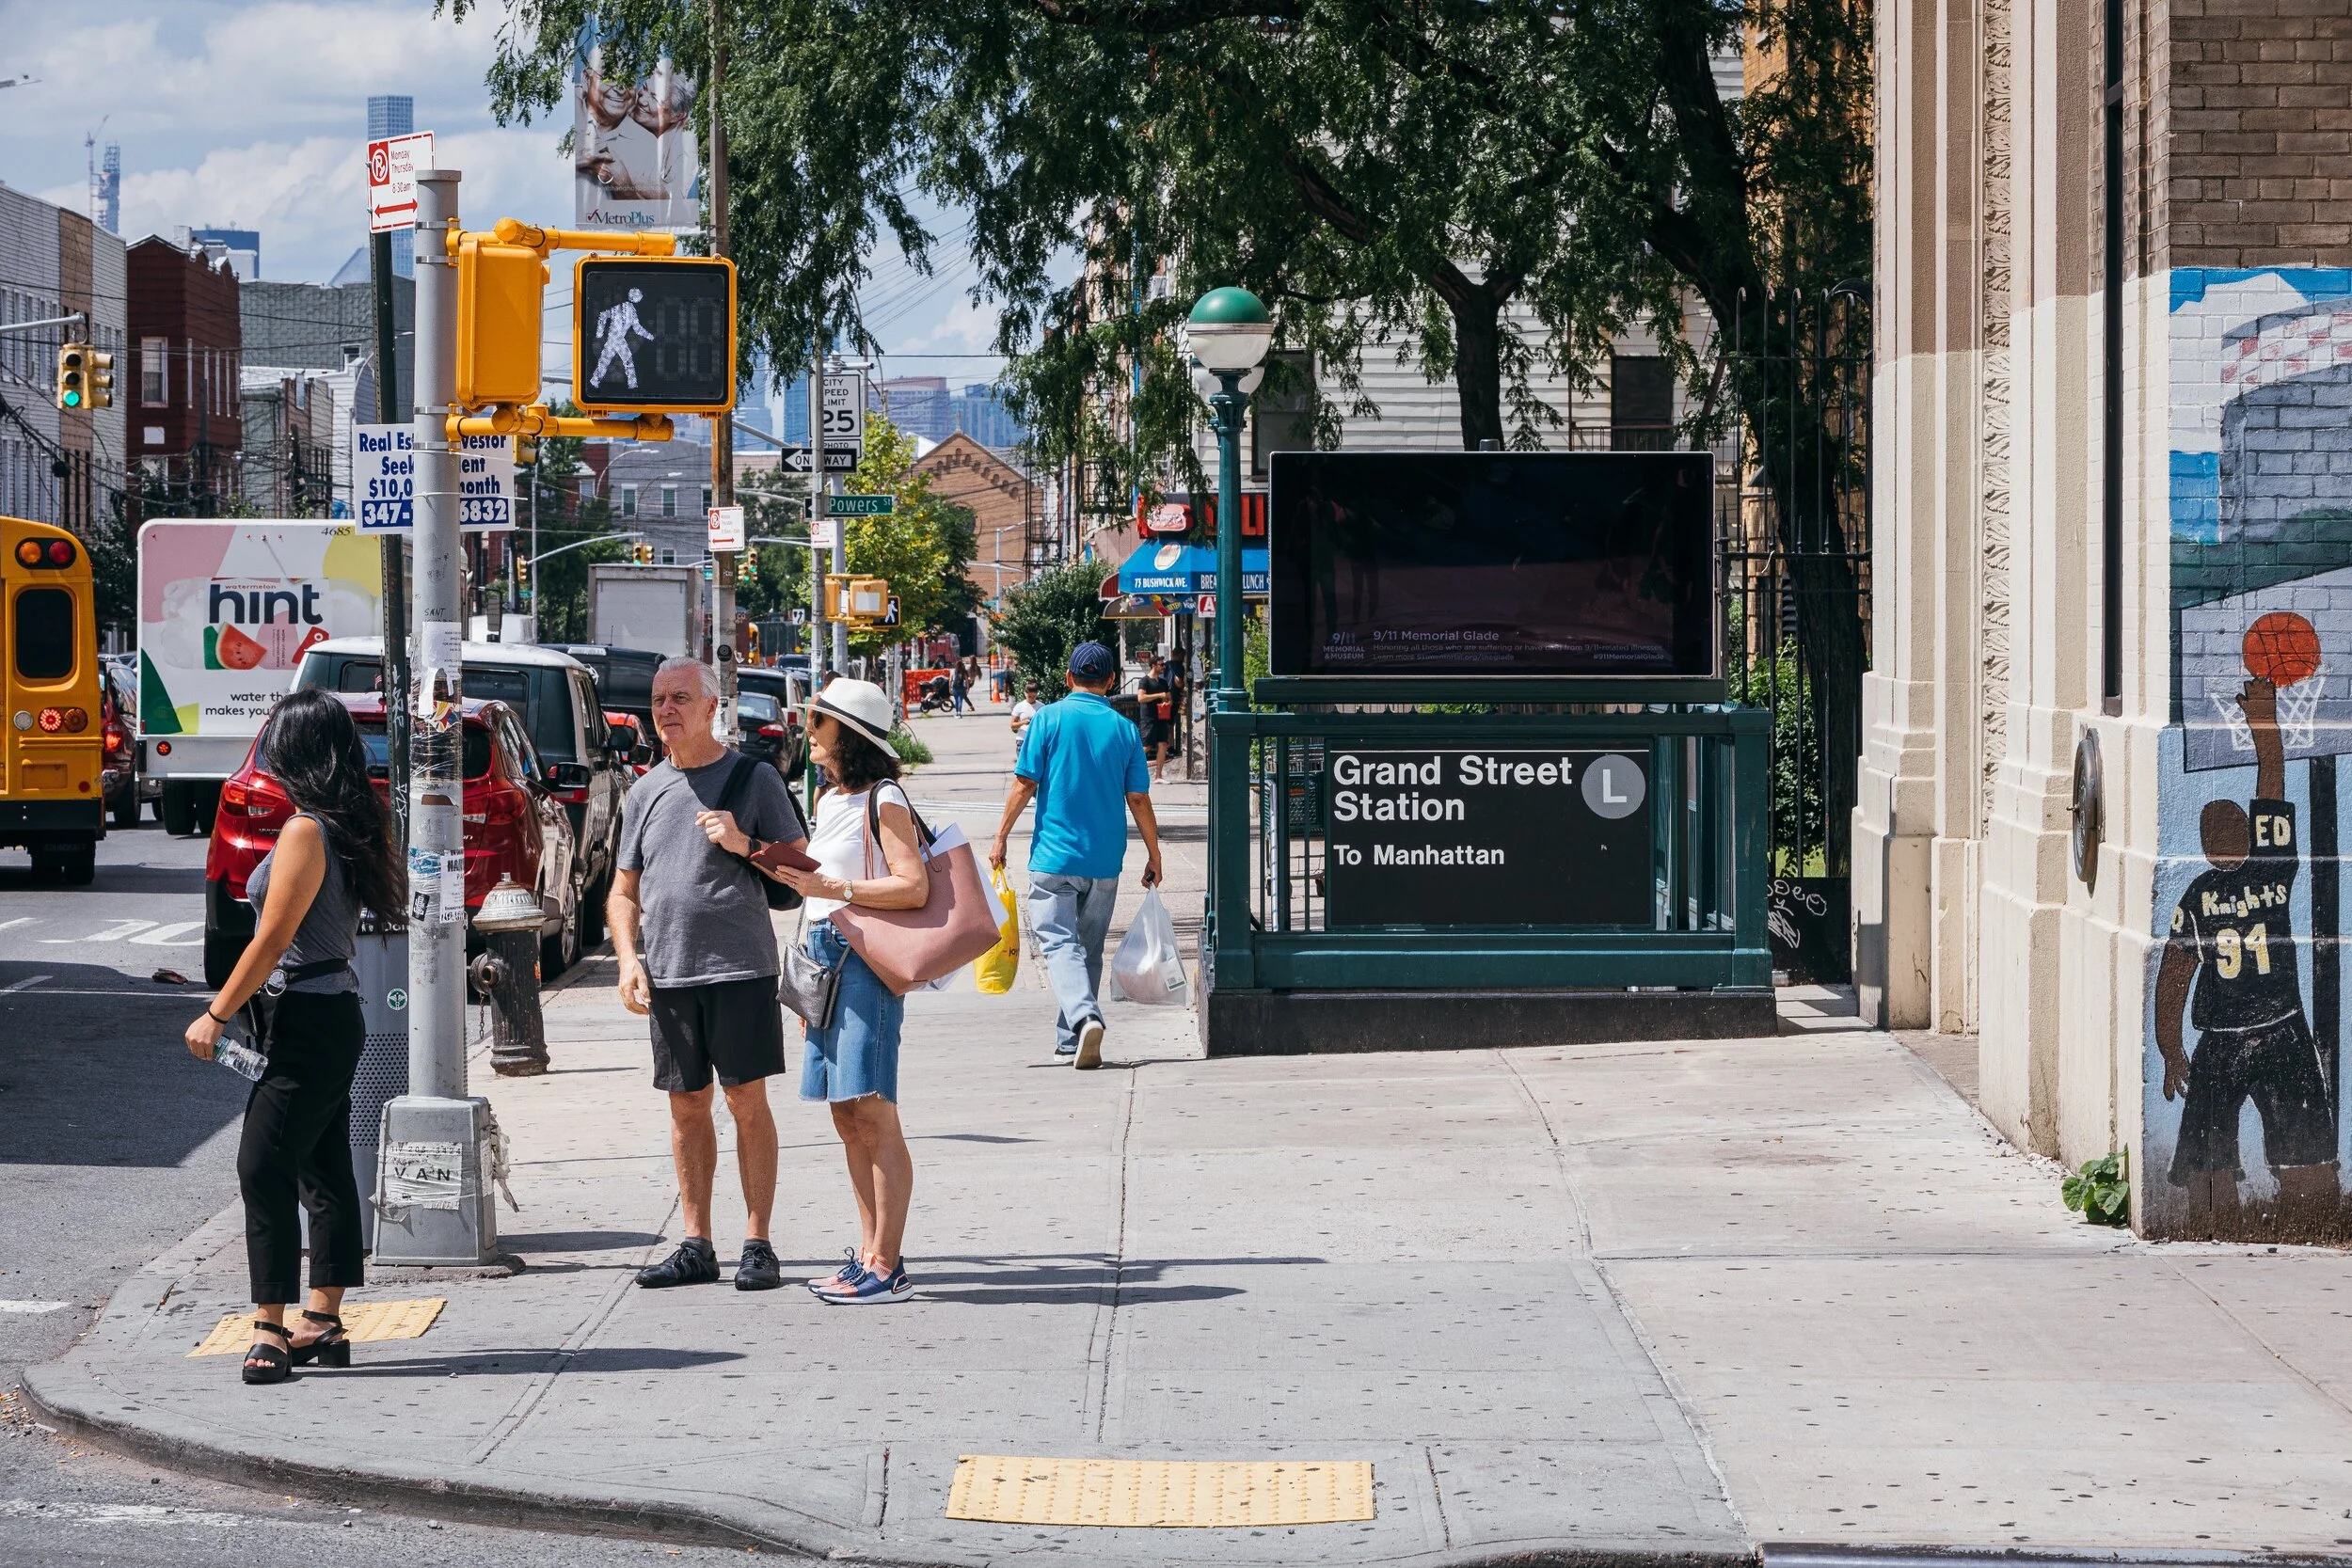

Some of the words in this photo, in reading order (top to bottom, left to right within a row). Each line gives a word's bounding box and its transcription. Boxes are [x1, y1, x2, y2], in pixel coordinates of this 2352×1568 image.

[390, 150, 410, 161] Monday
[391, 163, 414, 174] Thursday
[595, 211, 655, 225] MetroPlus
[823, 378, 844, 387] CITY
[824, 388, 850, 397] PEED
[823, 410, 855, 433] 25
[358, 431, 392, 452] Real
[461, 436, 507, 450] vestor
[459, 454, 486, 474] ent
[795, 455, 810, 466] ON
[824, 456, 847, 466] WAY
[369, 477, 414, 500] $10,0
[829, 498, 879, 513] Powers
[883, 498, 891, 506] St
[363, 501, 414, 526] 347-
[321, 526, 351, 536] 4685
[1142, 577, 1175, 588] BUSHWICK
[1200, 574, 1216, 590] BREA
[1243, 574, 1264, 590] LUNCH
[209, 583, 325, 626] hint
[1332, 631, 1356, 645] 9/11
[1373, 630, 1398, 642] 9/11
[1401, 629, 1459, 641] Memorial
[1463, 629, 1500, 641] Glade
[1373, 643, 1409, 653] Honoring
[1410, 643, 1420, 652] all
[1422, 643, 1444, 652] those
[1445, 643, 1462, 652] who
[1478, 643, 1513, 653] suffering
[1564, 643, 1582, 652] from
[1584, 643, 1629, 653] 9/11-related
[1373, 653, 1394, 661] Learn
[1593, 653, 1665, 661] #911MemorialGlade
[230, 691, 266, 703] water
[269, 690, 284, 703] th
[205, 703, 245, 717] makes
[1332, 753, 1441, 786] Grand
[1458, 754, 1573, 786] Street
[1602, 768, 1628, 804] L
[1332, 790, 1466, 822] Station
[2255, 814, 2292, 847] ED
[1332, 844, 1362, 866] To
[1373, 844, 1505, 866] Manhattan
[2201, 884, 2287, 917] Knights
